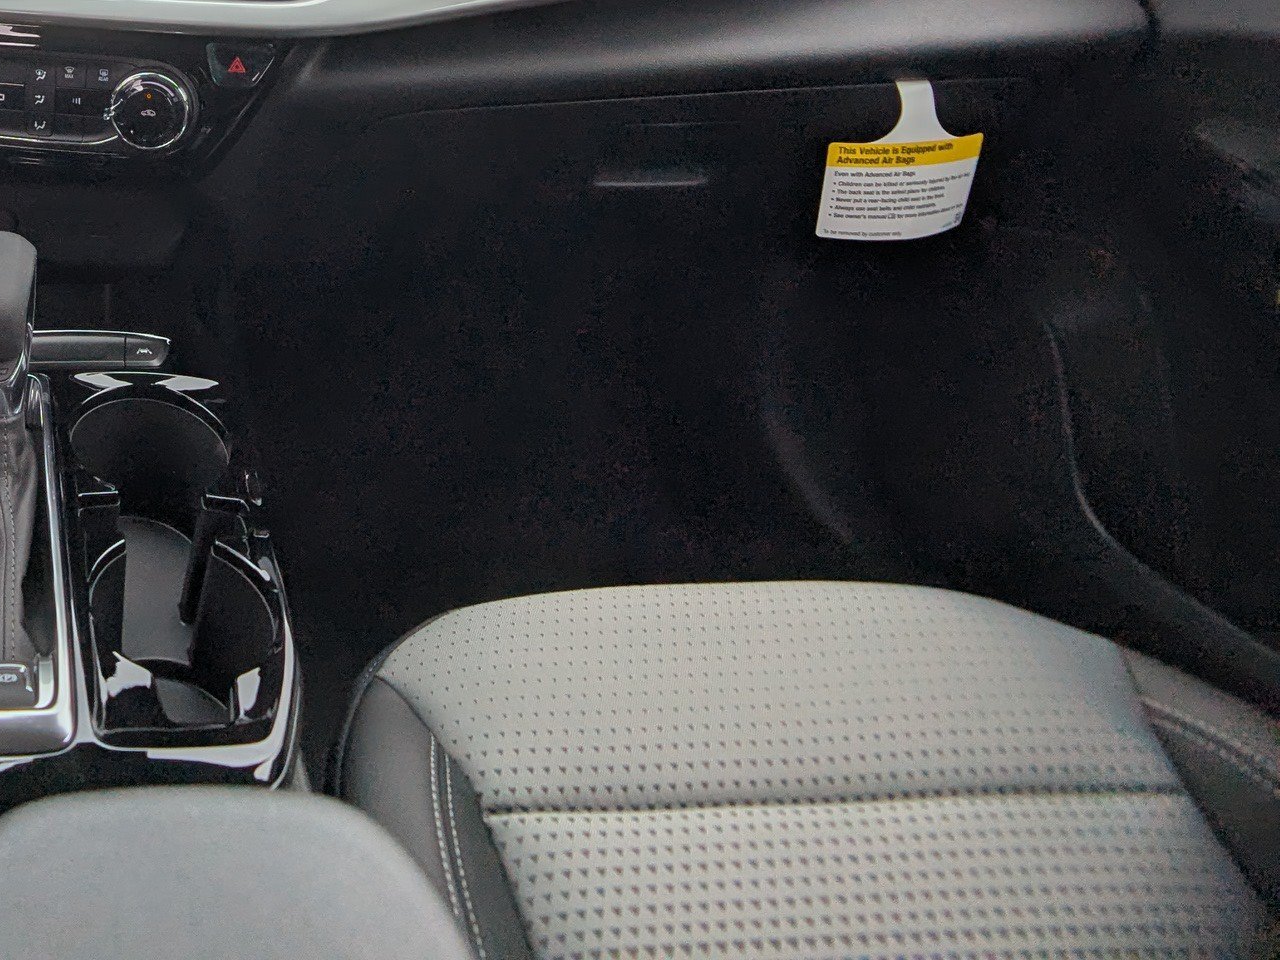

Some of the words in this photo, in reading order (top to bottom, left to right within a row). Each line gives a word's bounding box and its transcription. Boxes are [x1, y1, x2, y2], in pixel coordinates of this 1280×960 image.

[839, 146, 856, 155] This
[859, 146, 890, 155] Vehicle
[892, 147, 899, 155] is
[901, 145, 937, 155] Equipped
[938, 142, 953, 151] with
[837, 156, 879, 165] Advanced
[882, 156, 894, 165] Air
[895, 156, 915, 165] Bags
